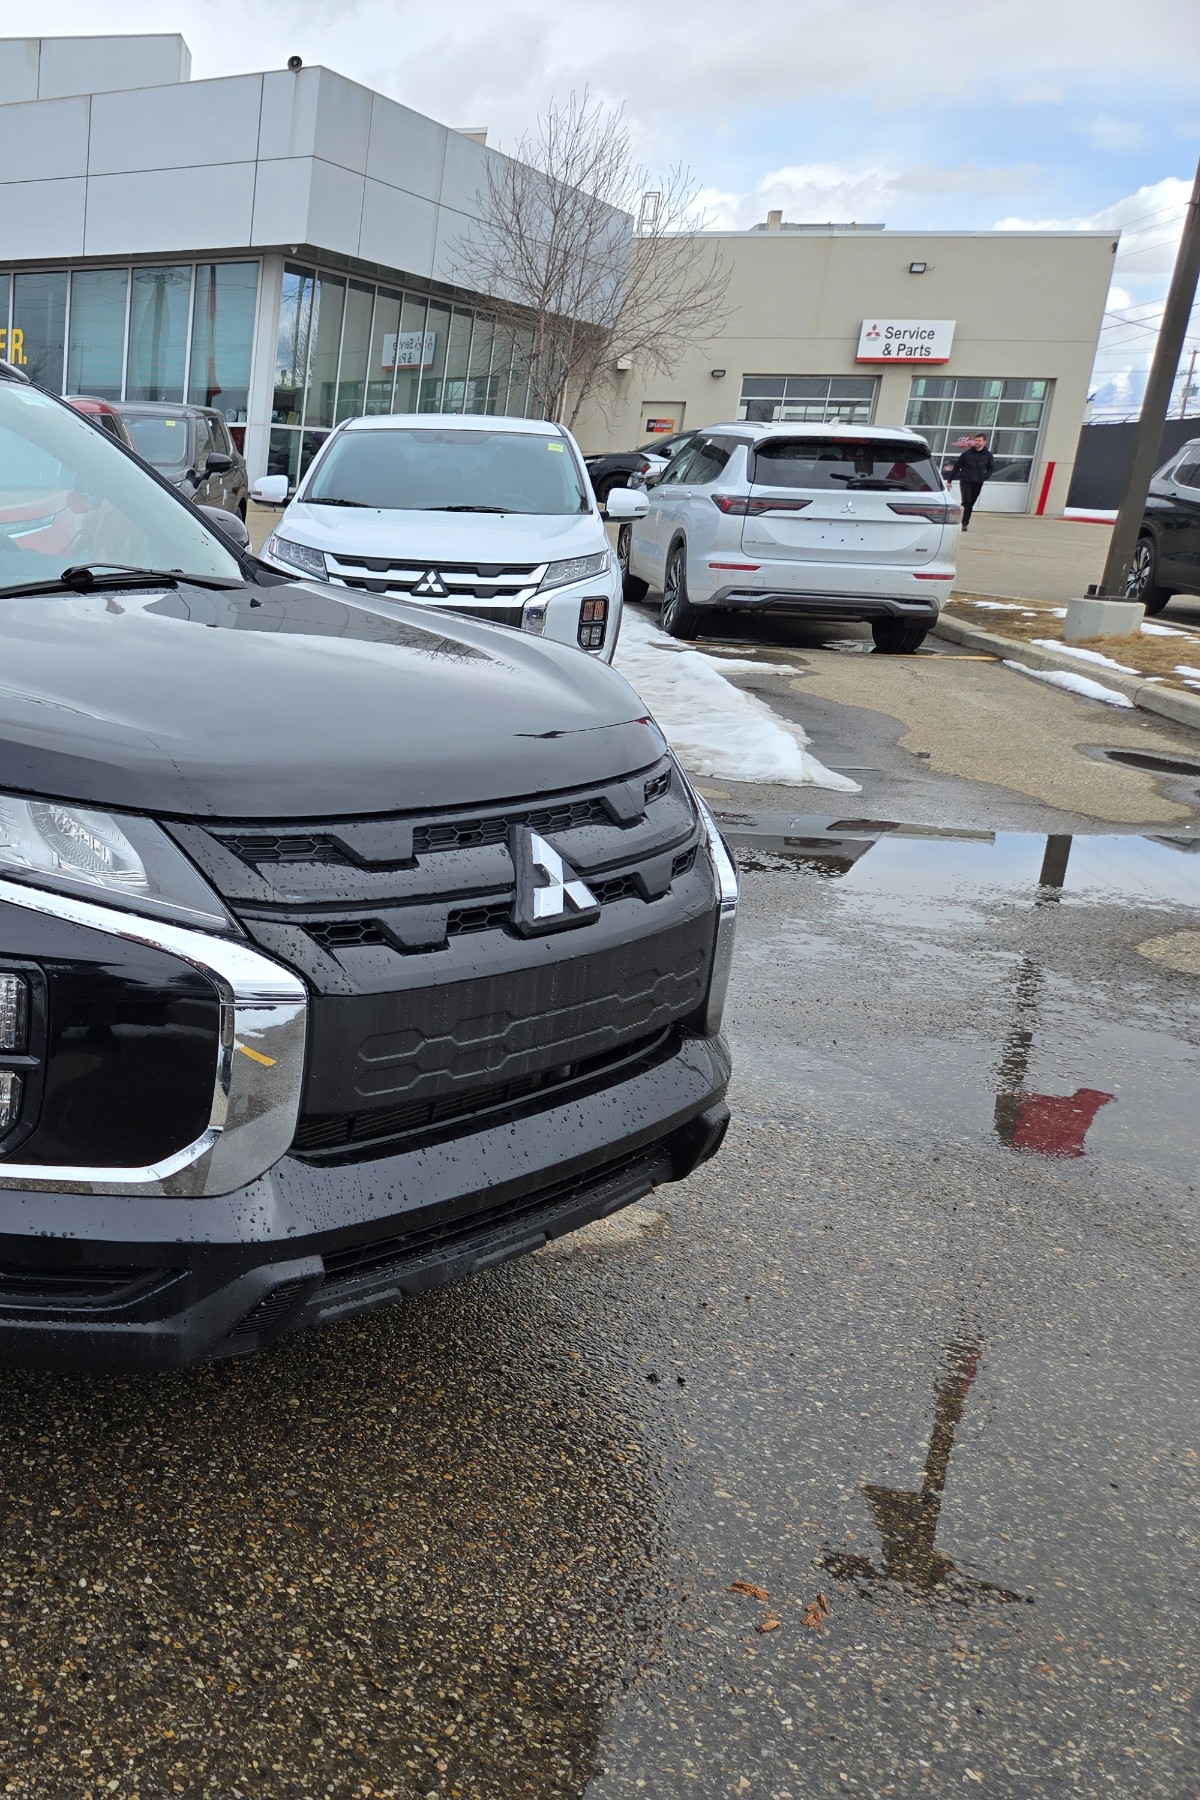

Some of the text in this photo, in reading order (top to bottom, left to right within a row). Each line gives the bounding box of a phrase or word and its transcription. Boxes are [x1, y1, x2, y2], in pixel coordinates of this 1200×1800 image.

[884, 326, 935, 340] Service
[882, 343, 931, 357] & Parts
